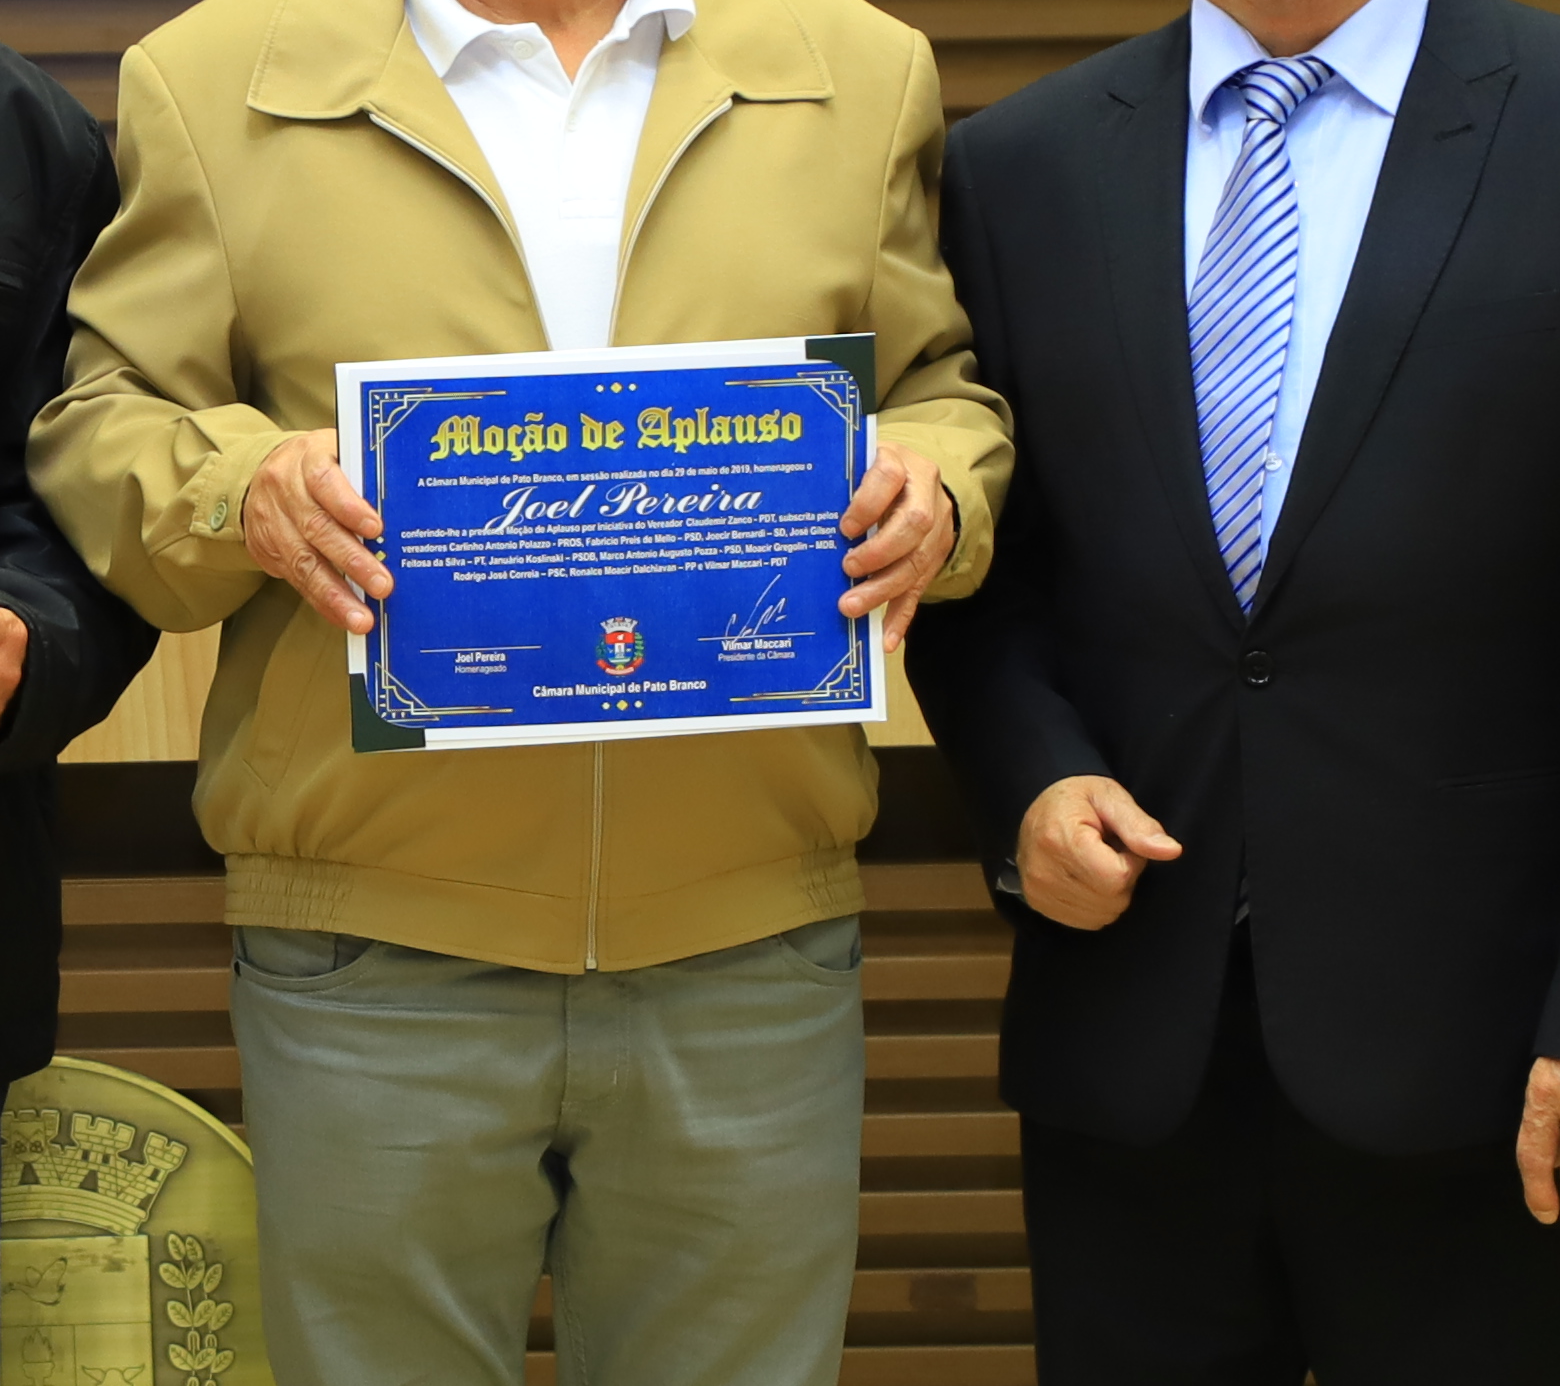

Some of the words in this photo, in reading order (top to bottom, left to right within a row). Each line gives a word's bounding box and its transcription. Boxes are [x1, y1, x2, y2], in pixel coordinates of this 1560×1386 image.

[429, 411, 567, 462] Moção
[579, 412, 625, 451] de
[636, 405, 802, 453] Aplauso
[424, 476, 458, 487] Câmara
[458, 474, 499, 486] Municipal
[511, 473, 532, 483] Pato
[532, 473, 564, 483] Branco,
[579, 470, 610, 481] sessão
[610, 468, 647, 479] realizada
[659, 467, 674, 477] dia
[696, 465, 718, 475] maio
[730, 463, 752, 474] 2019,
[752, 463, 806, 473] homenageou
[481, 483, 596, 534] Joel
[598, 481, 763, 516] Pereira
[720, 638, 752, 651] Vilmar
[753, 637, 792, 649] Maccari
[454, 651, 474, 663] Joel
[474, 651, 506, 662] Pereira
[532, 685, 574, 697] Câmara
[574, 681, 626, 696] Municipal
[626, 681, 641, 693] de
[642, 680, 667, 692] Pato
[668, 679, 706, 691] Branco
